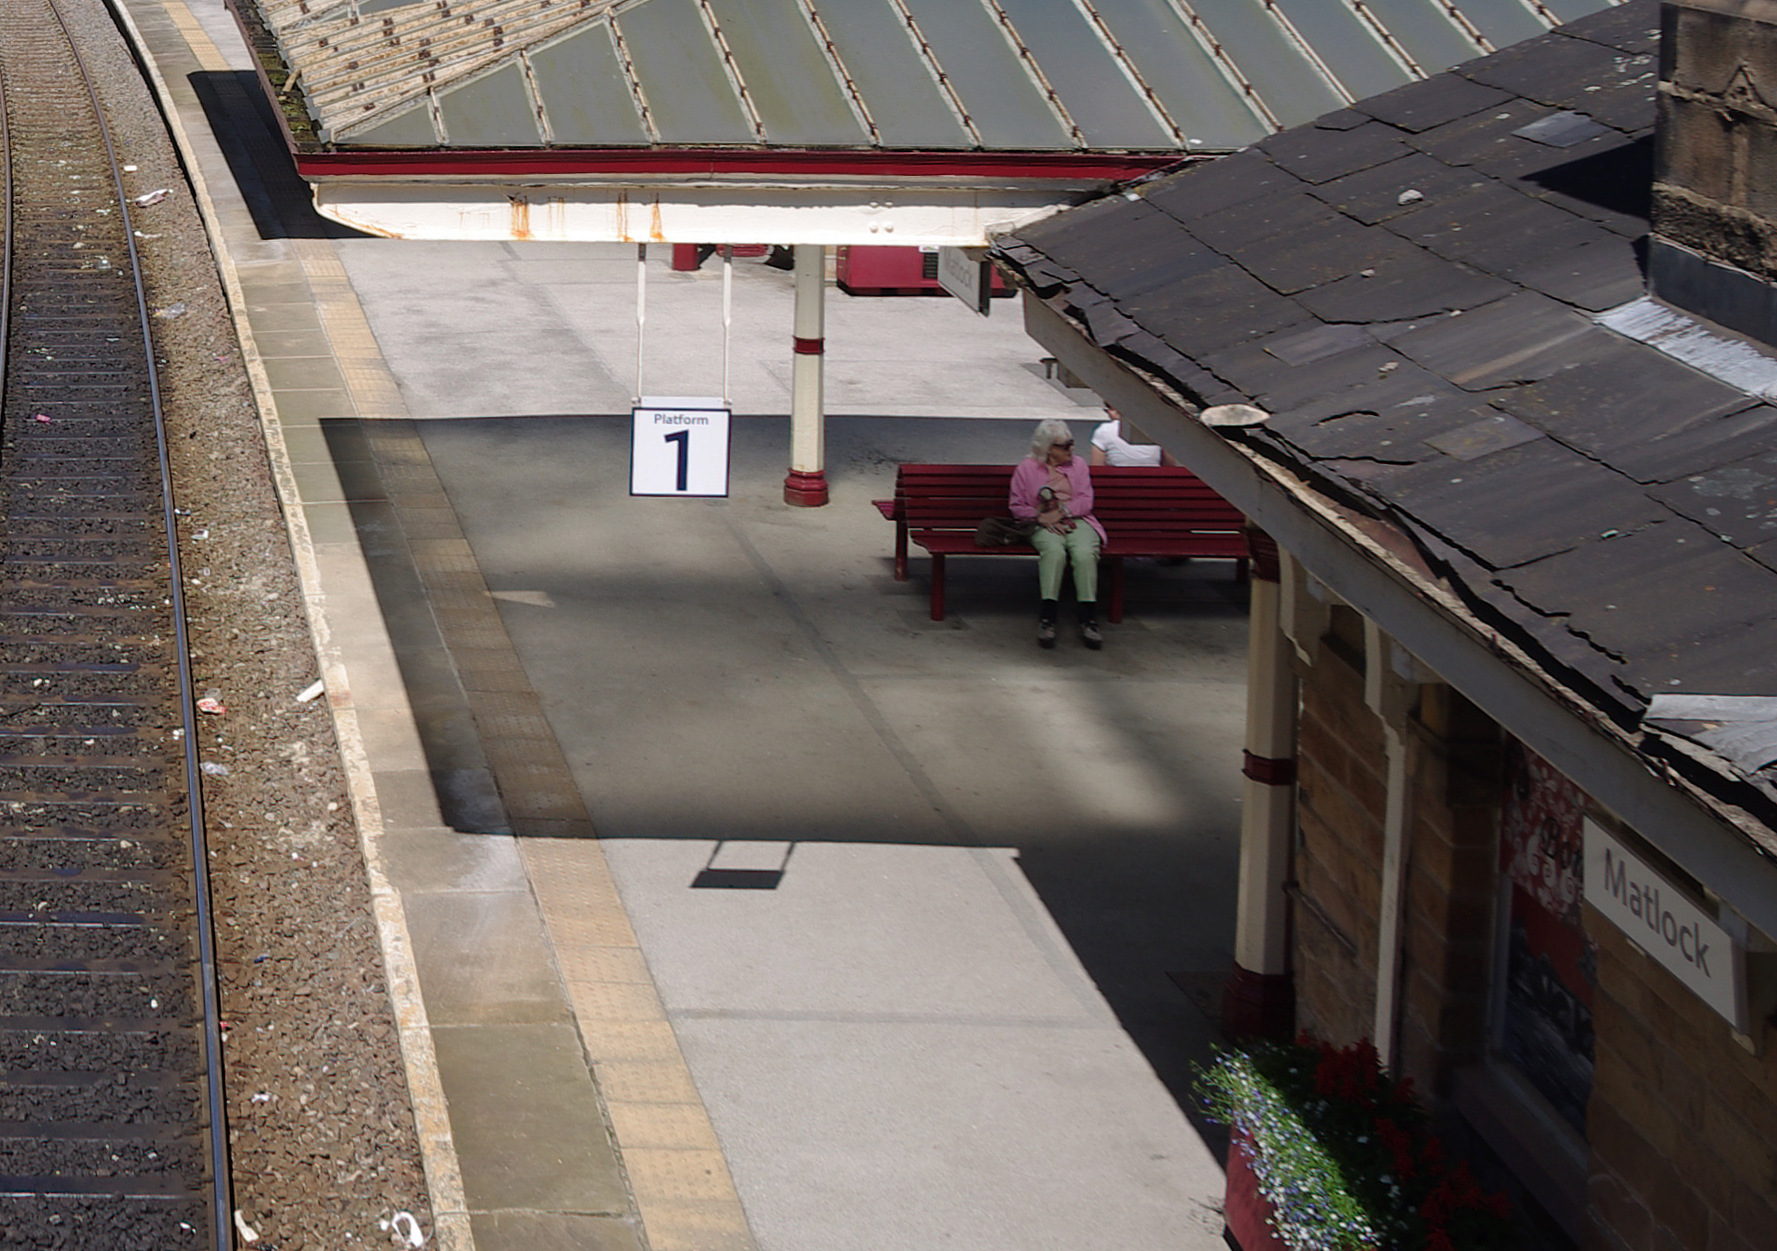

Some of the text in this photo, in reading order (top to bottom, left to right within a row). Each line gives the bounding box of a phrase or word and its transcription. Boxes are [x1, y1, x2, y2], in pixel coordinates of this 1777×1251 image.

[653, 413, 710, 425] Platform
[664, 429, 690, 491] 1
[1605, 848, 1711, 979] Matlock
